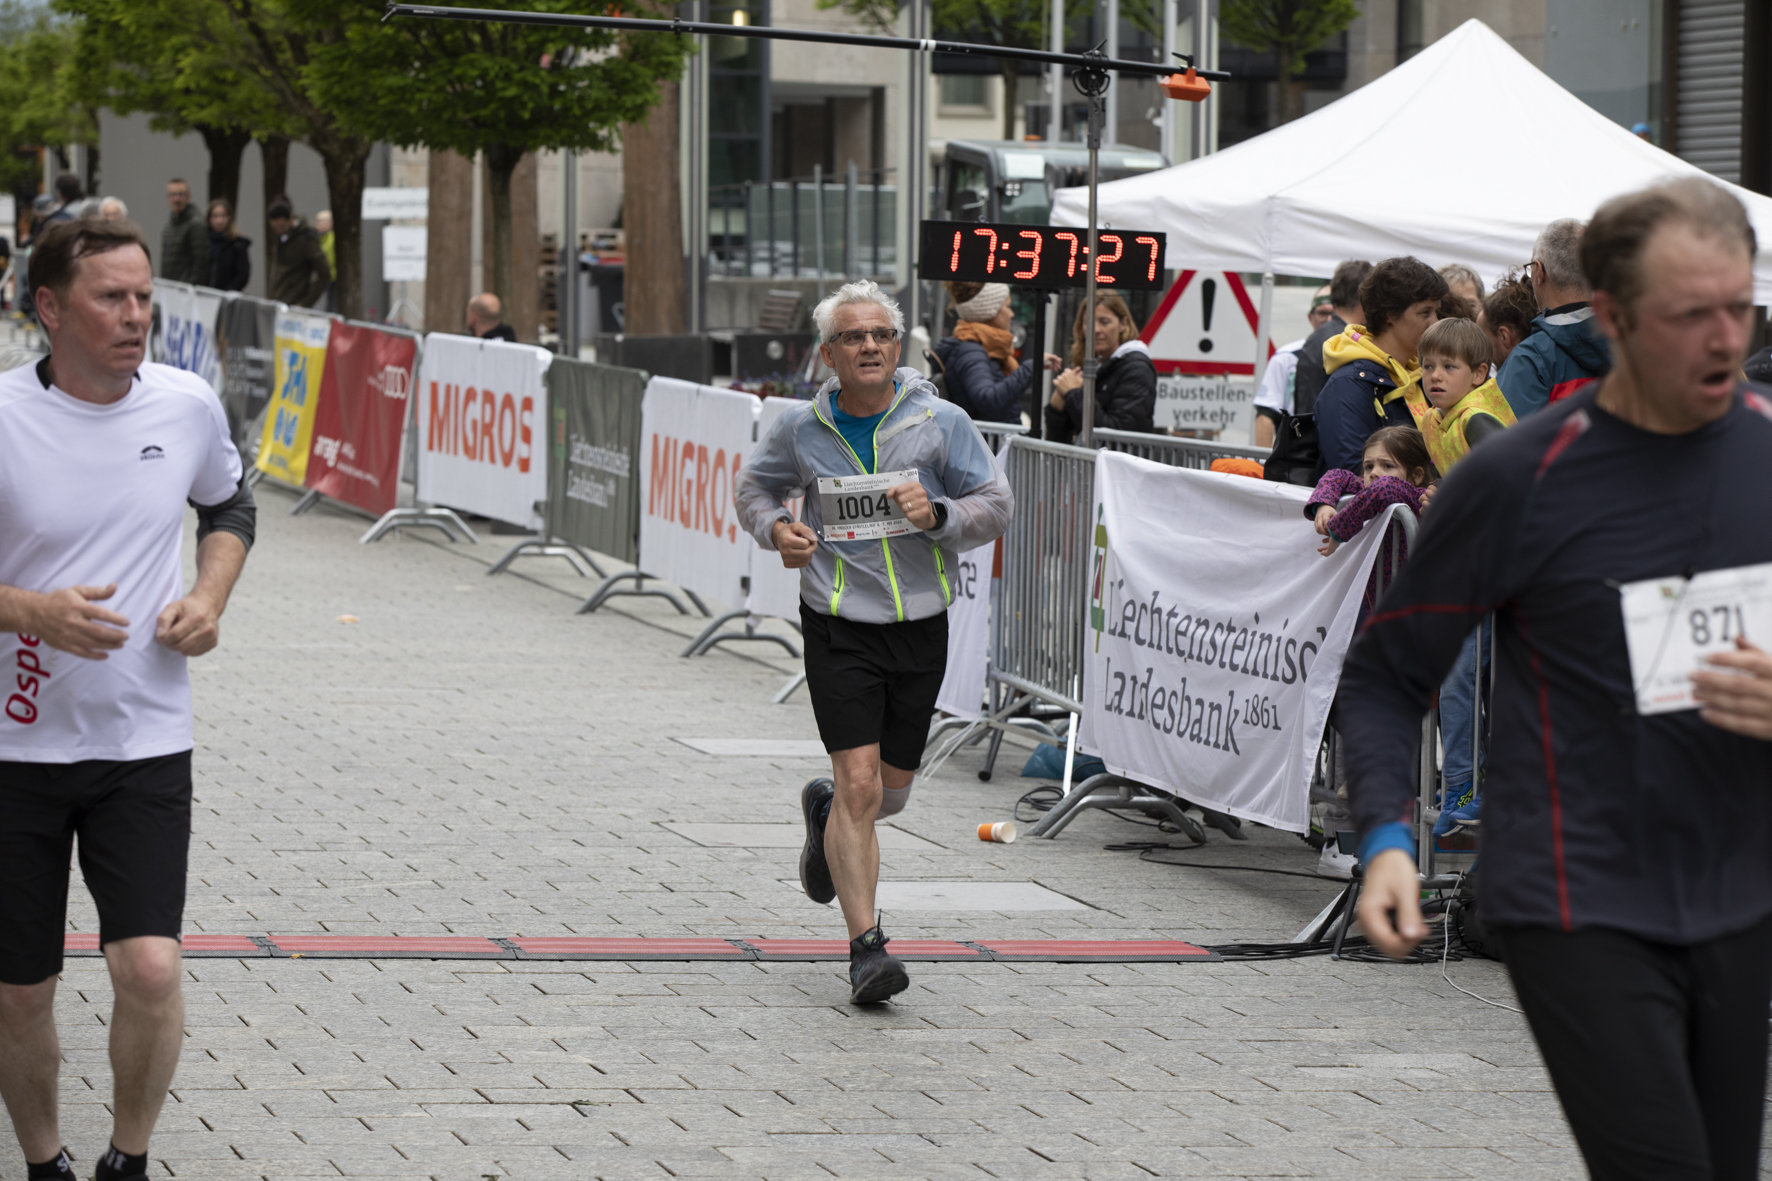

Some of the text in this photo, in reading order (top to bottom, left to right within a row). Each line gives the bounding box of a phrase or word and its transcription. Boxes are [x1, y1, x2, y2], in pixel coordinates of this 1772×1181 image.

[950, 228, 1158, 284] 17:37:27
[1158, 383, 1253, 401] Baustellen-
[427, 380, 533, 474] MIGROS
[1173, 405, 1236, 424] verkehr
[843, 478, 891, 487] Liechtensteinische
[837, 493, 892, 520] 1004
[1107, 578, 1327, 685] Liechtensteinisc
[1104, 656, 1282, 756] Landesbank 1861
